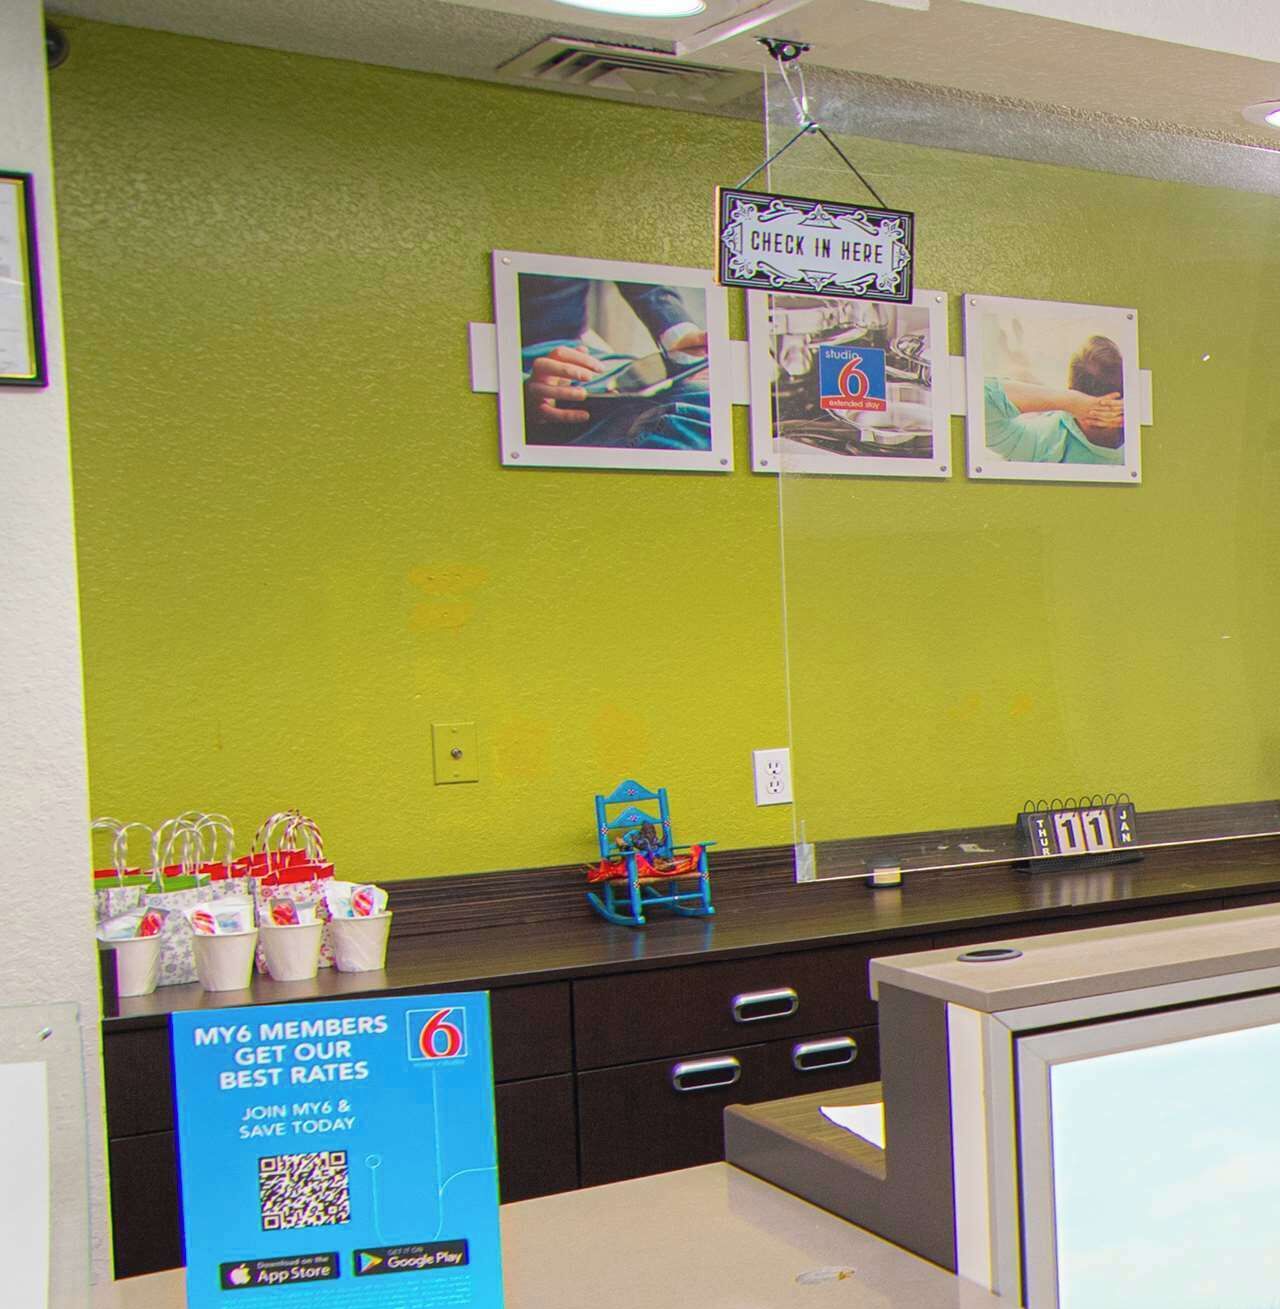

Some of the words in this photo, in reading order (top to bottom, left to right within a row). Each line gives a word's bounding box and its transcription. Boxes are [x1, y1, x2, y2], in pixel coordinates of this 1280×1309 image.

[751, 230, 804, 256] CHECK
[815, 238, 831, 258] IN
[841, 241, 883, 264] HERE
[825, 349, 859, 360] studio
[838, 357, 869, 399] 6
[829, 400, 863, 408] extended
[1036, 819, 1051, 857] THUR
[1120, 810, 1132, 843] JAN
[194, 1025, 252, 1046] MY6
[259, 1015, 389, 1042] MEMBERS
[419, 1008, 463, 1059] 6
[234, 1045, 287, 1066] GET
[294, 1040, 351, 1061] OUR
[220, 1068, 282, 1090] BEST
[290, 1061, 369, 1085] RATES
[242, 1104, 286, 1121] JOIN
[292, 1101, 333, 1117] MY6
[338, 1099, 351, 1113] &
[239, 1122, 286, 1140] SAVE
[291, 1116, 356, 1135] TODAY
[387, 1253, 435, 1268] Google
[436, 1250, 463, 1264] Play
[257, 1269, 290, 1284] App
[290, 1265, 331, 1280] Store
